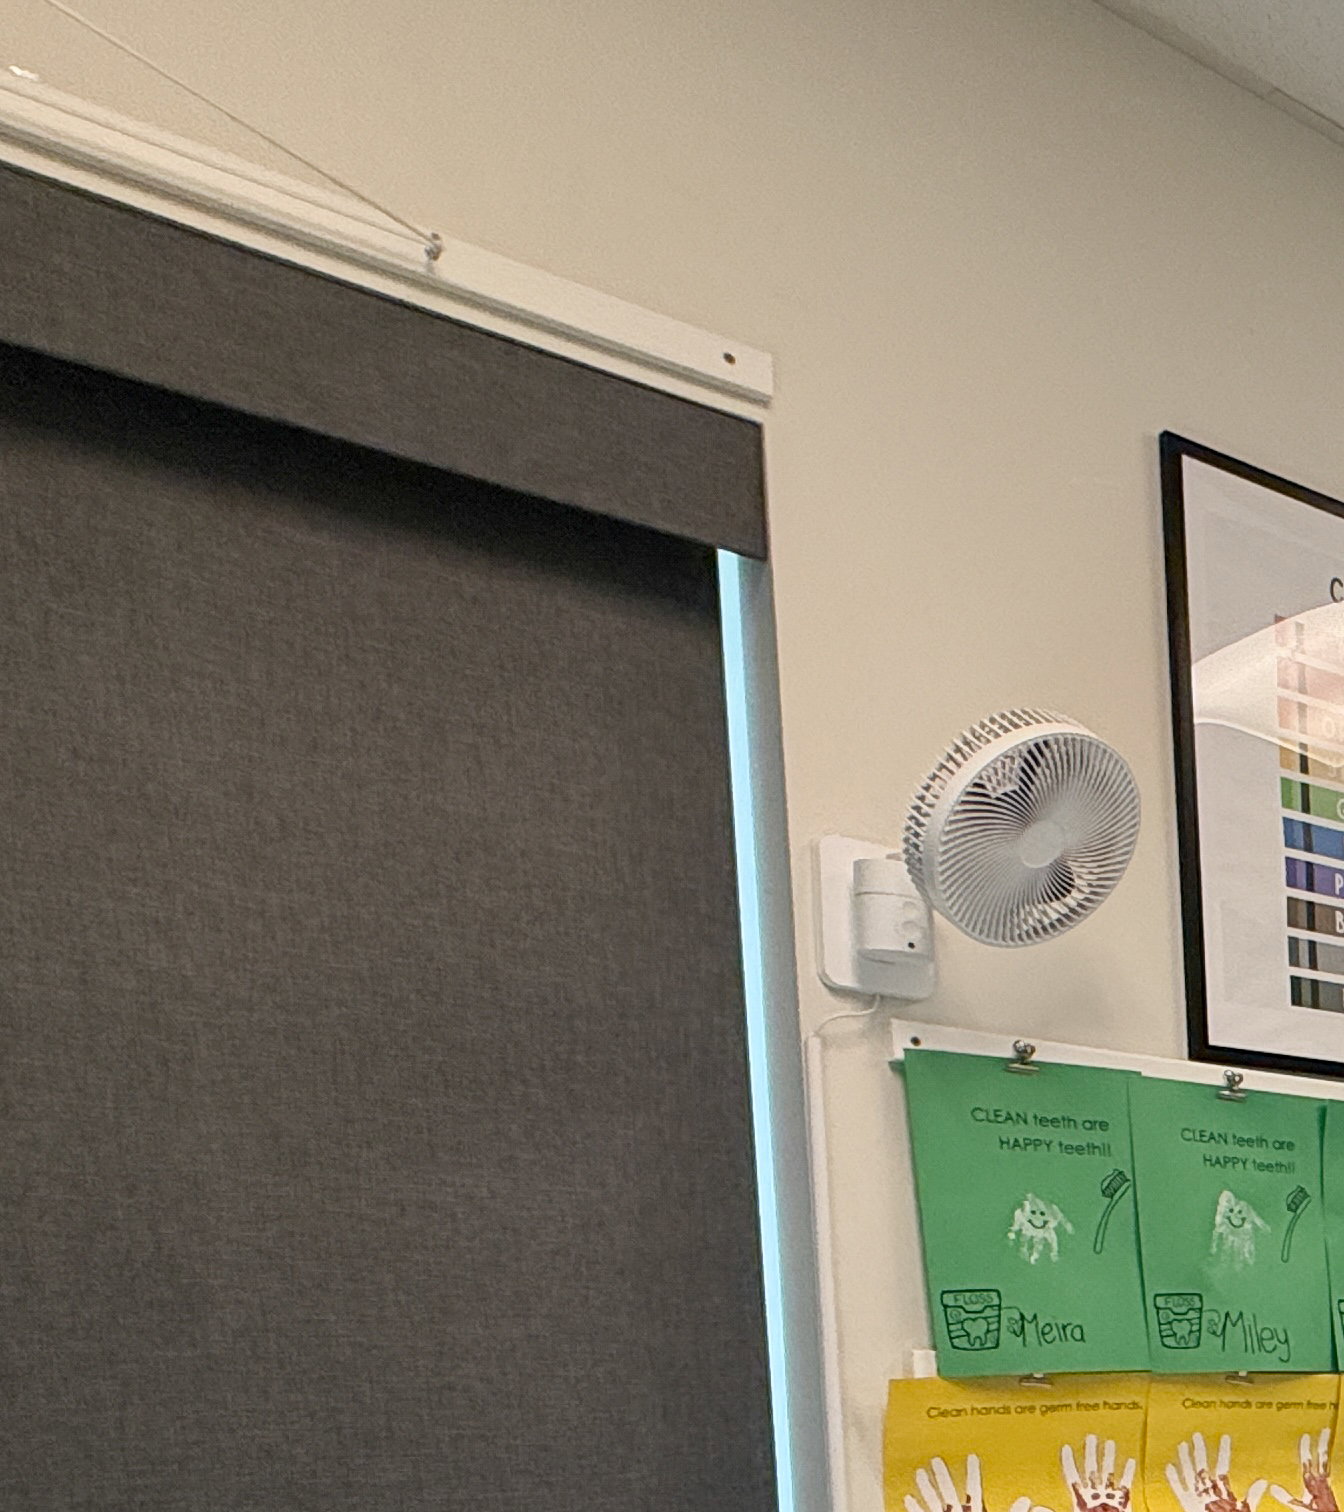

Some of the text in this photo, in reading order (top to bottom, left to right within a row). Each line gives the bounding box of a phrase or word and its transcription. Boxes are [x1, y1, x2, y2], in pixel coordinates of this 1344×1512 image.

[970, 1107, 1109, 1132] CLEAN teeth are
[999, 1136, 1052, 1153] HAPPY
[1181, 1127, 1295, 1151] CLEAN teeth are
[1203, 1154, 1249, 1170] HAPPY
[953, 1293, 994, 1305] FLOSS
[1164, 1296, 1196, 1308] FLOSS
[1018, 1311, 1086, 1348] Meira
[1219, 1310, 1292, 1362] Miley
[926, 1405, 967, 1419] Clean
[971, 1402, 1011, 1415] hands
[1015, 1404, 1036, 1415] are
[1039, 1403, 1072, 1418] germ
[1076, 1401, 1100, 1412] free
[1182, 1398, 1216, 1410] Clean
[1219, 1399, 1252, 1409] hands
[1255, 1401, 1273, 1410] are
[1276, 1401, 1304, 1412] germ
[1306, 1400, 1327, 1410] free
